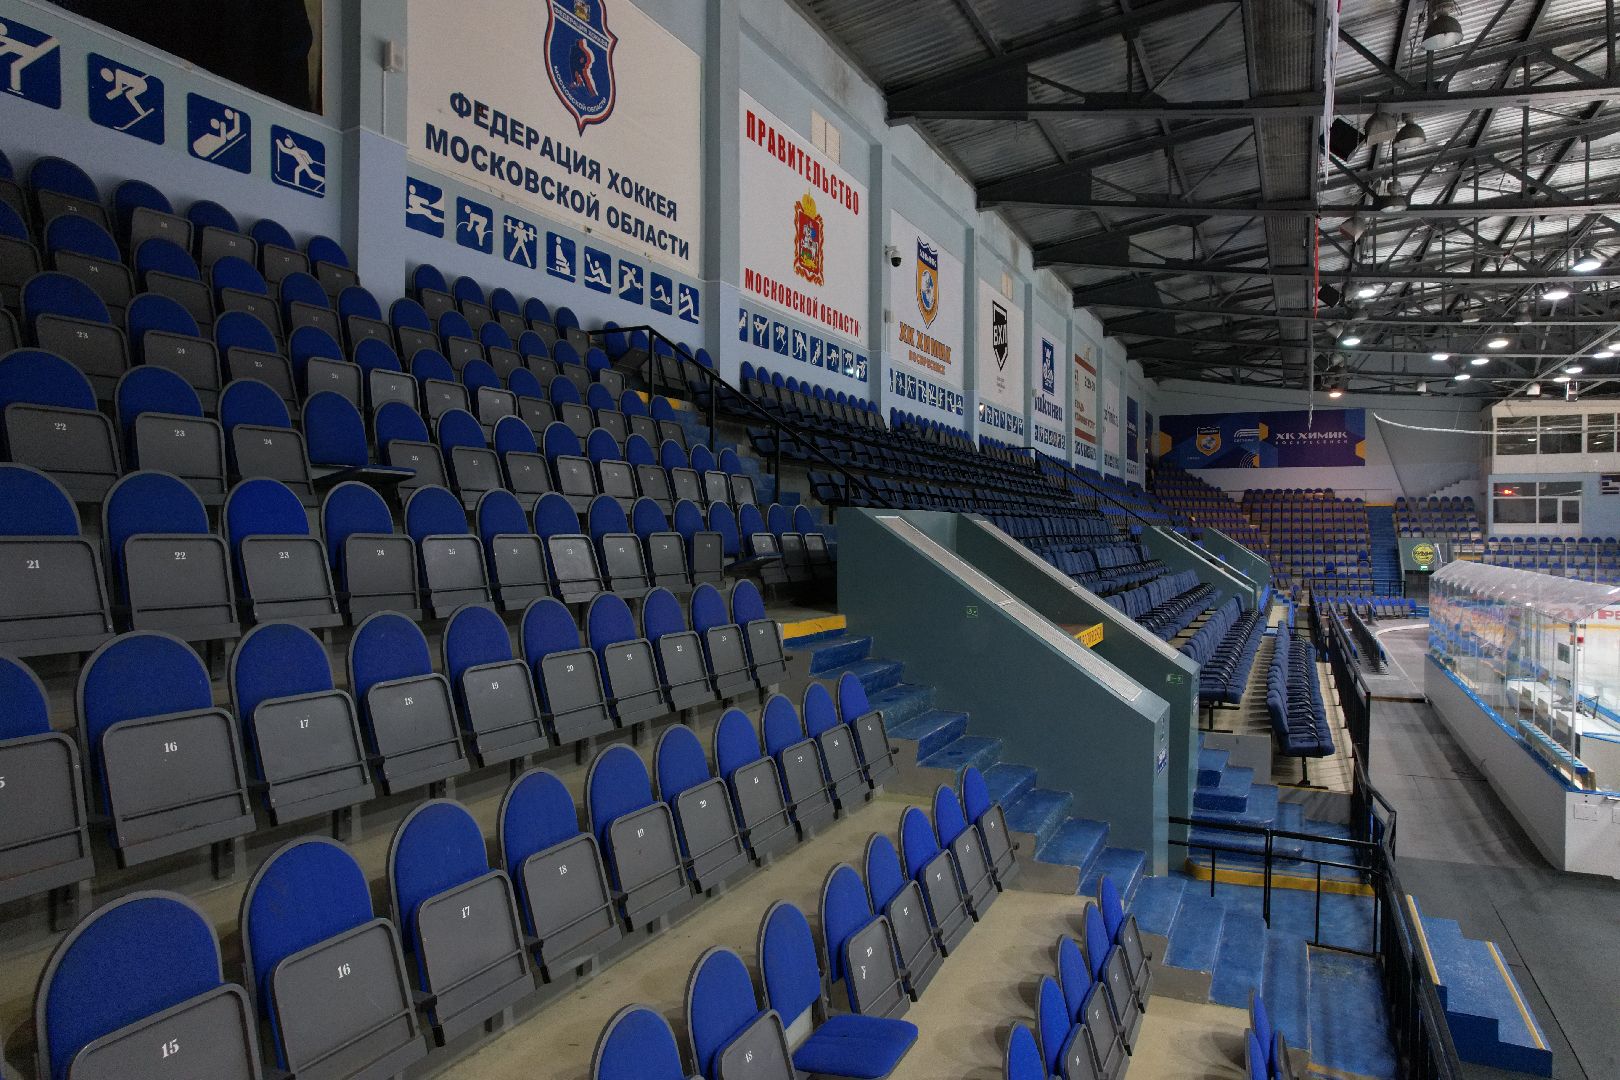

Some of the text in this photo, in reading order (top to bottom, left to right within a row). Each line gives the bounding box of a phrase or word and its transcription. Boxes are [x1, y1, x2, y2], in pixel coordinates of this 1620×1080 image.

[553, 65, 587, 112] МОСКОВСКОЙ
[449, 91, 678, 222] ФЕДЕРАЦИЯ ХОККЕЯ
[746, 109, 859, 216] ПРАВИТЕЛЬСТВО
[425, 123, 689, 261] МОСКОВСКОЙ ОБЛАСТИ
[745, 267, 859, 338] МОСКОВСКОЙ ОБЛАСТИ
[54, 422, 67, 431] 22
[174, 429, 185, 437] 23
[1275, 431, 1348, 440] ХК ХИМИК
[174, 551, 187, 560] 22
[278, 551, 290, 559] 23
[26, 559, 40, 569] 21
[404, 696, 414, 706] 18
[300, 719, 309, 729] 17
[164, 741, 178, 753] 16
[558, 864, 568, 876] 18
[461, 905, 470, 919] 17
[337, 963, 351, 979] 16
[161, 1038, 180, 1059] 15
